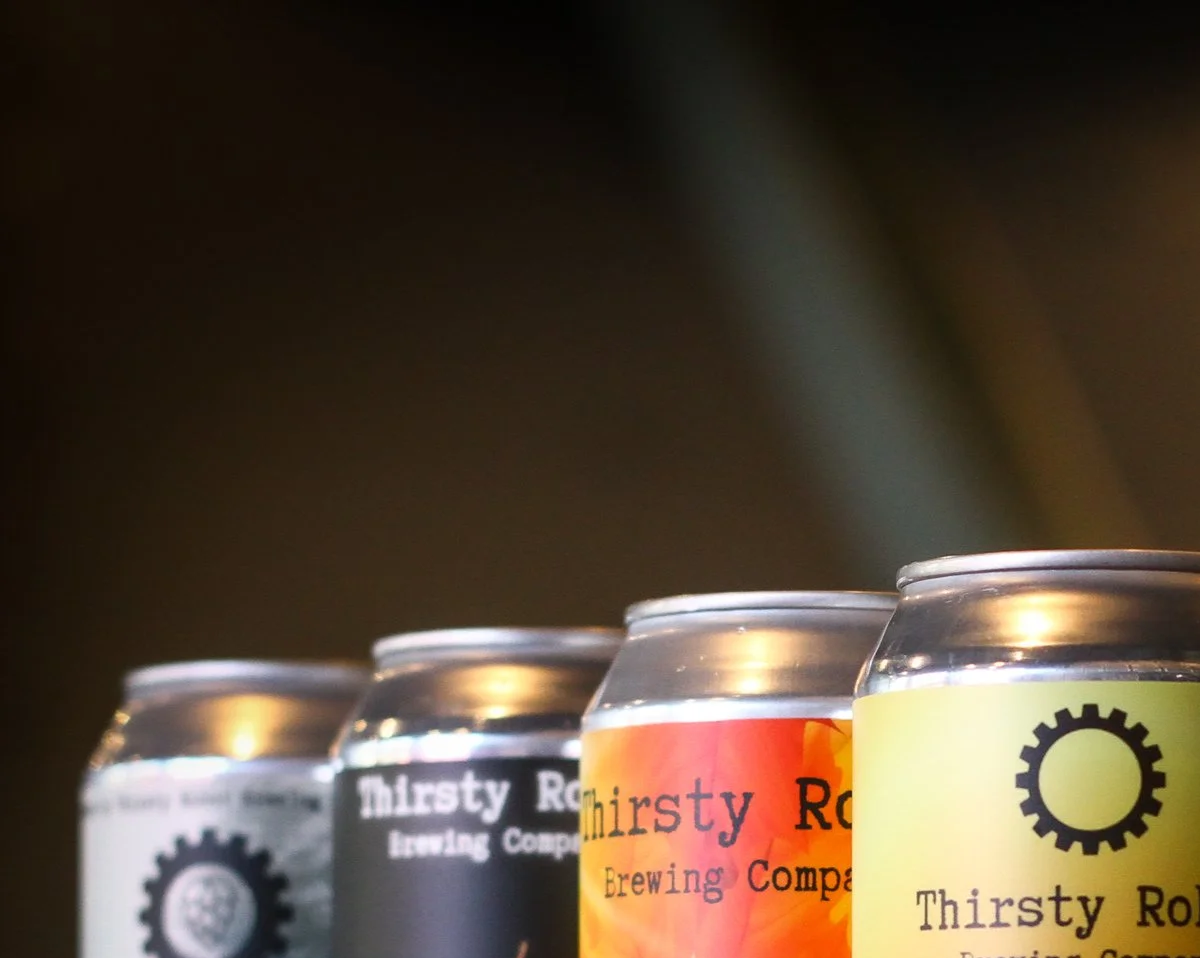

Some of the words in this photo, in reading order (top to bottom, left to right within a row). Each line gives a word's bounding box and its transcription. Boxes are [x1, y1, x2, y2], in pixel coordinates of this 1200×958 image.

[357, 770, 511, 824] Thirsty
[583, 776, 754, 848] Thirsty
[387, 829, 490, 863] Brewing
[604, 862, 724, 904] Brewing
[917, 885, 1104, 939] Thirsty
